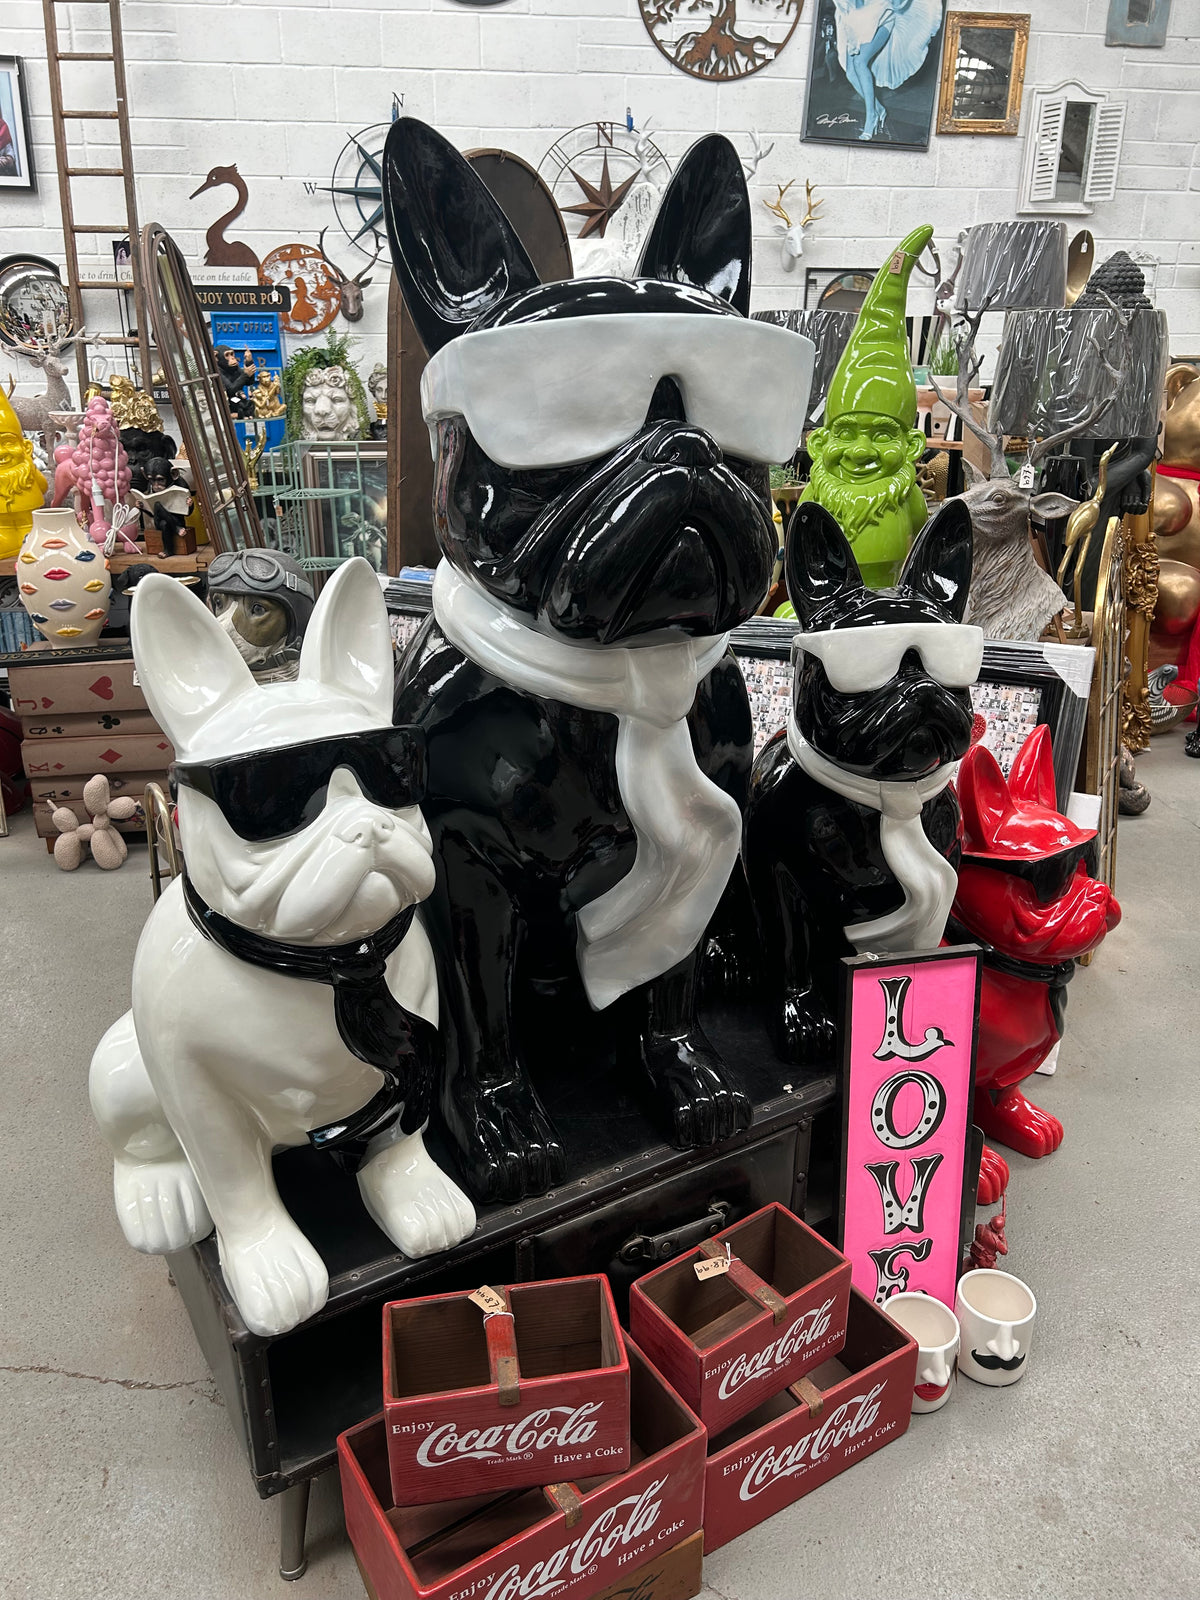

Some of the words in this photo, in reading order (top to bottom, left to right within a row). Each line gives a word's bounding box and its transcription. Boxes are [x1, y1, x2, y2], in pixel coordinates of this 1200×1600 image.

[302, 182, 318, 196] W
[218, 272, 228, 281] the
[232, 272, 252, 282] table
[226, 292, 258, 305] YOUR
[215, 321, 241, 333] POST
[243, 321, 274, 333] OFFICE
[718, 1294, 837, 1400] Coca-Cola
[802, 1345, 821, 1361] Have
[827, 1329, 845, 1344] Coke
[704, 1357, 733, 1380] Enjoy
[392, 1421, 435, 1434] Enjoy
[416, 1401, 604, 1467] Coca-Cola
[739, 1379, 888, 1501] Coca-Cola
[844, 1441, 866, 1458] Have
[874, 1420, 897, 1437] Coke
[553, 1452, 582, 1464] Have
[595, 1446, 624, 1457] Coke
[722, 1451, 758, 1477] Enjoy
[448, 1572, 496, 1600] Enjoy
[483, 1473, 670, 1600] Coca-Cola
[617, 1544, 646, 1567] Have
[648, 1538, 655, 1547] a
[657, 1517, 686, 1541] Coke
[550, 1584, 569, 1598] Trade
[570, 1572, 587, 1586] Mark
